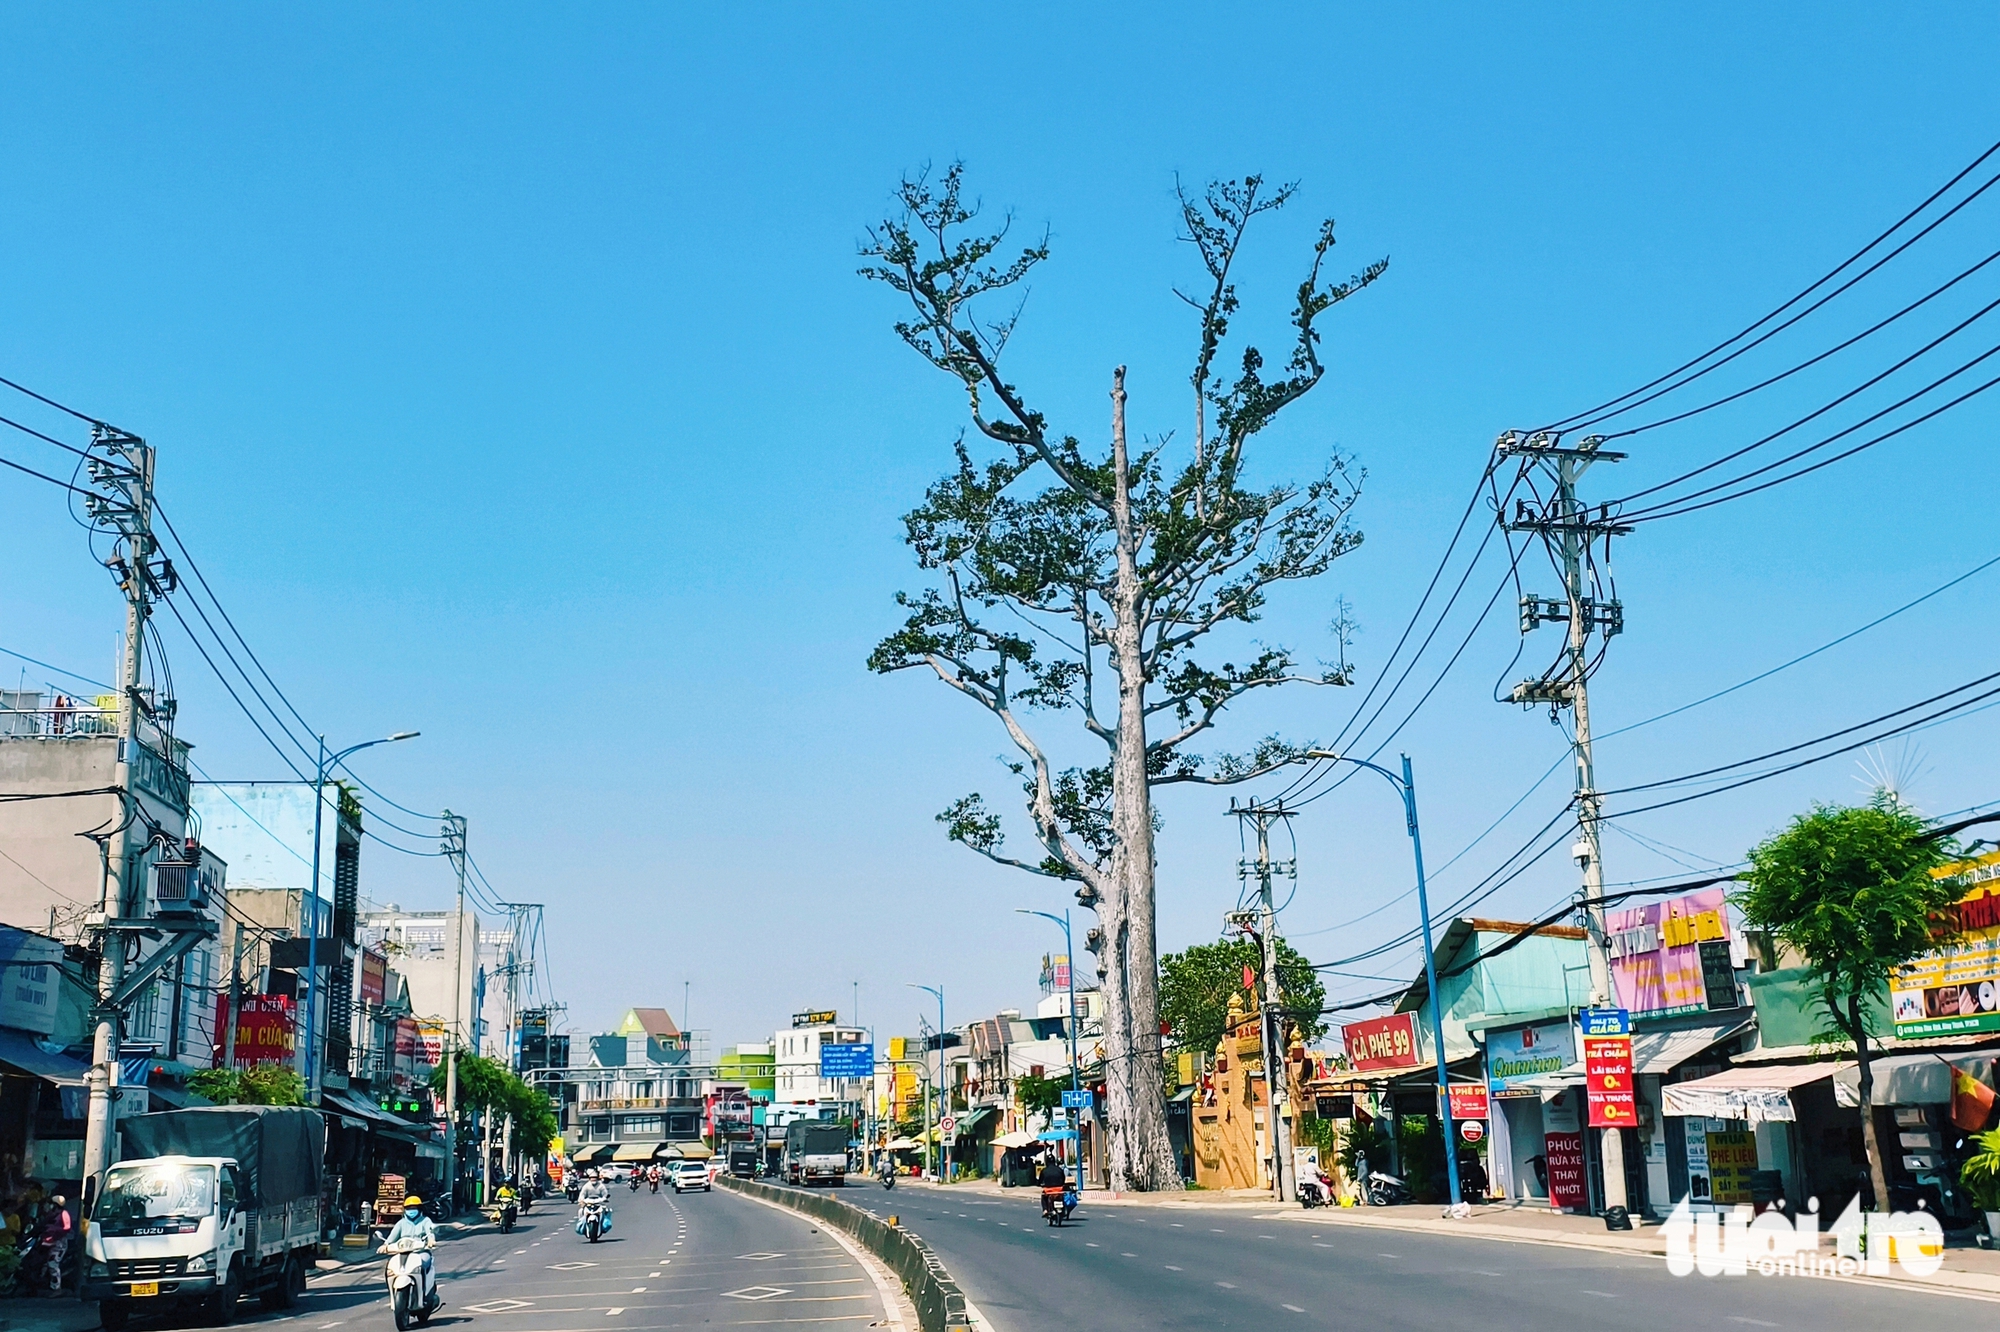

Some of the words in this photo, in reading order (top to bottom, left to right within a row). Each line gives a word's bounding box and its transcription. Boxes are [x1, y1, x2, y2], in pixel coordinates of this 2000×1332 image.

[1352, 1030, 1369, 1061] CÀ
[1368, 1025, 1394, 1059] PHÊ
[1394, 1029, 1410, 1056] 99
[1493, 1055, 1562, 1079] Quantum
[1455, 1086, 1473, 1095] PHÊ
[1475, 1087, 1486, 1095] 99
[1547, 1137, 1580, 1151] PHÚC
[1714, 1133, 1747, 1145] MUA
[1549, 1154, 1569, 1166] RỬA
[1570, 1155, 1582, 1165] XE
[1554, 1170, 1579, 1180] THAY
[1555, 1183, 1581, 1195] NHỚT
